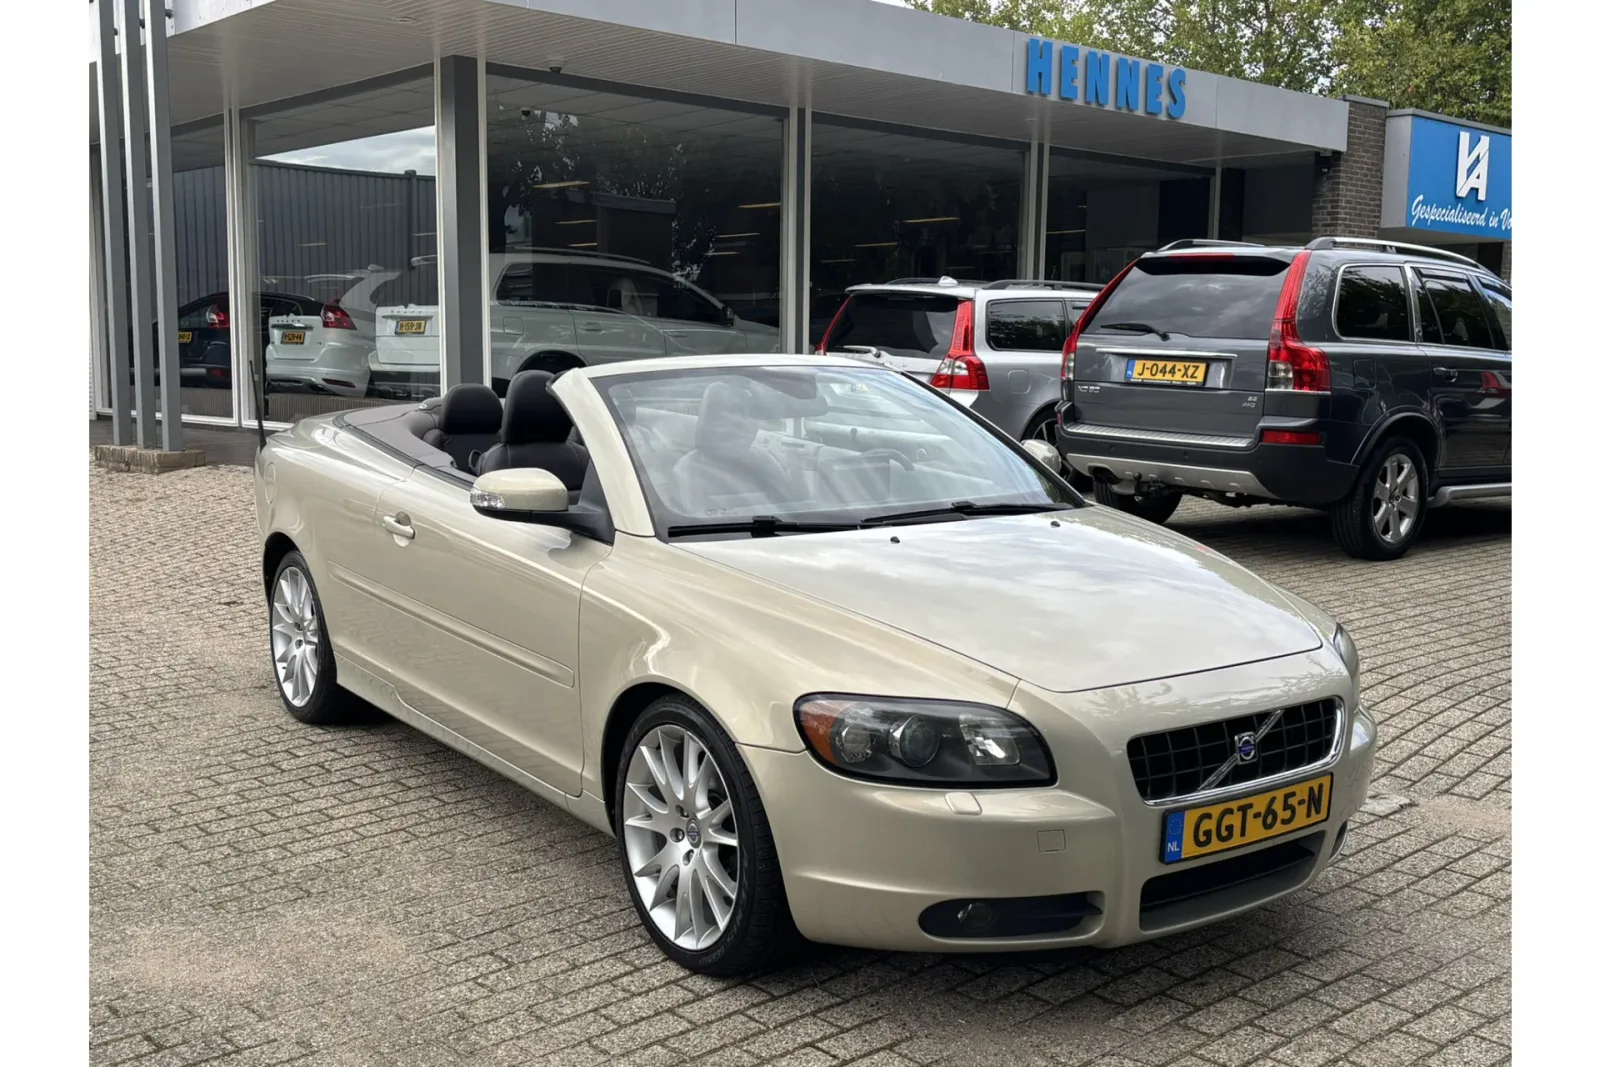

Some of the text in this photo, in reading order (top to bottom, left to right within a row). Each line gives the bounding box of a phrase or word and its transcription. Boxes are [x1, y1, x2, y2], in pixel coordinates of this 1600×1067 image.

[1027, 38, 1187, 119] HENNES
[1411, 194, 1488, 226] Gespecialiseerd
[1488, 211, 1499, 228] in
[1137, 362, 1200, 379] J-044-XZ
[1193, 782, 1325, 848] GGT-65-N
[1167, 841, 1180, 852] NL
